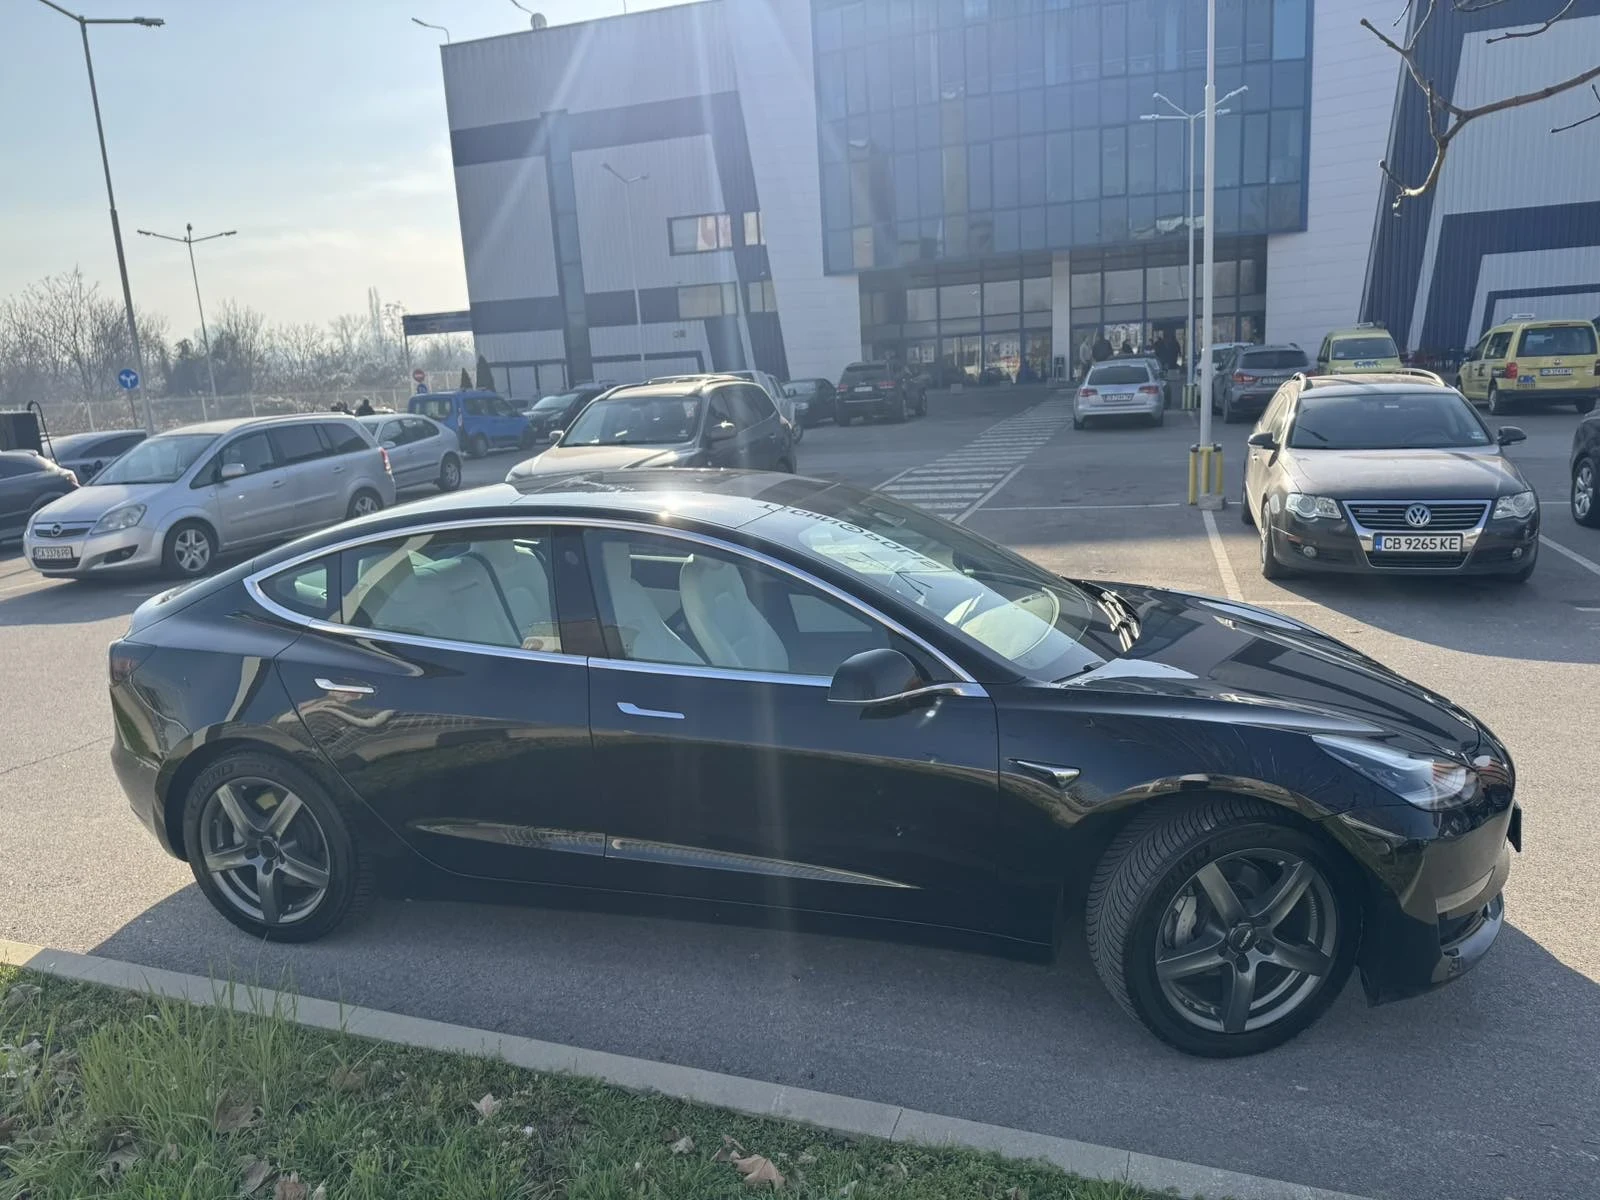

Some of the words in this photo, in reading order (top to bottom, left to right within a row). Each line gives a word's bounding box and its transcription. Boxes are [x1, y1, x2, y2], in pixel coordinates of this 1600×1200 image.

[1384, 537, 1402, 550] CB
[1404, 537, 1437, 550] 9265
[1439, 537, 1458, 549] KE
